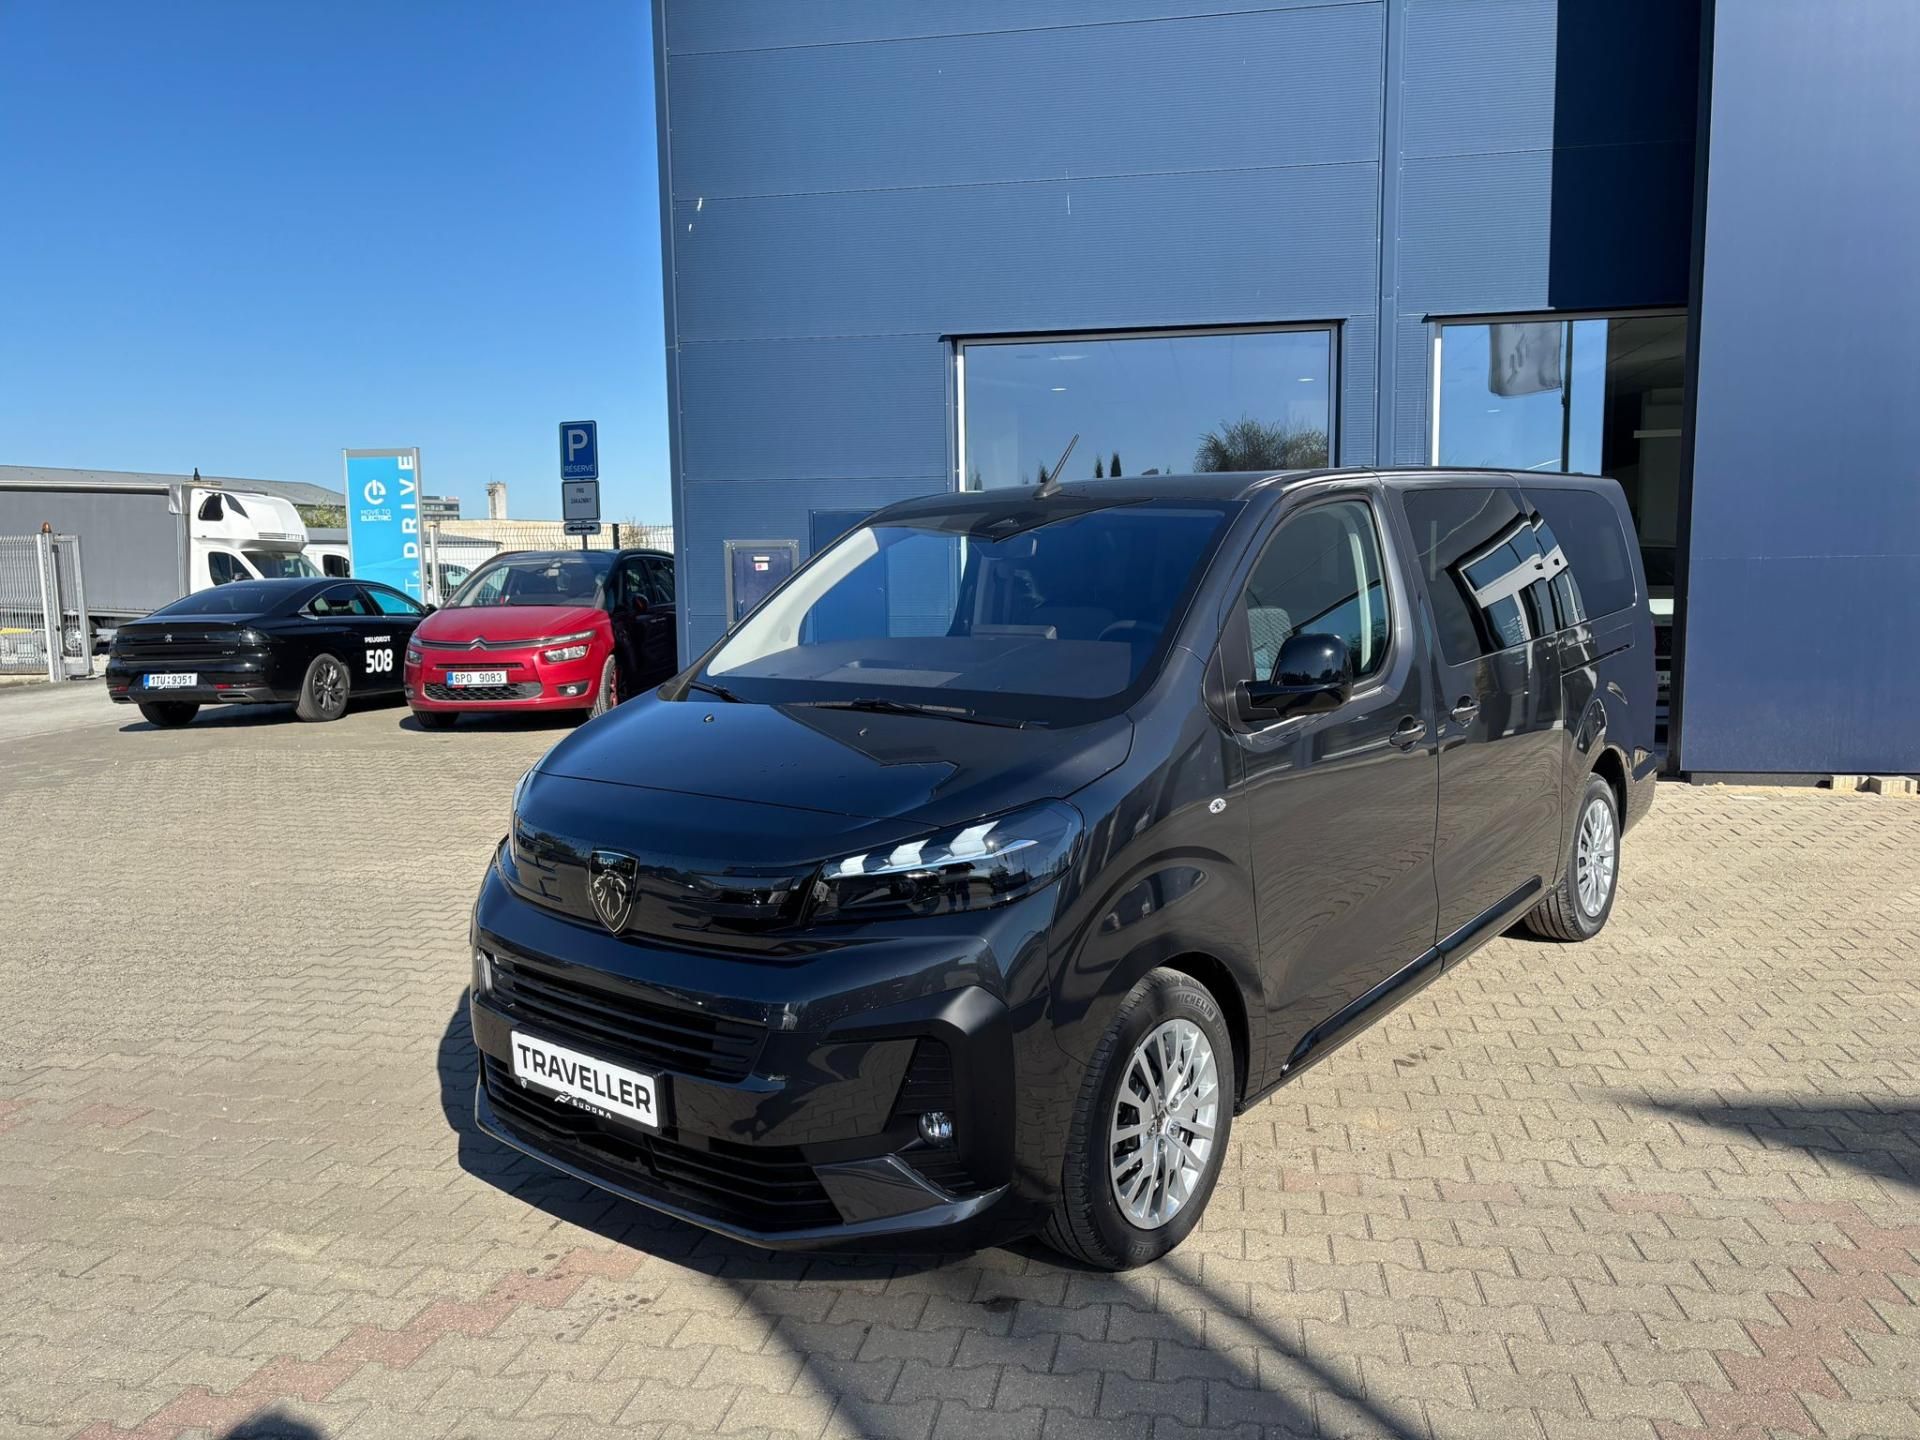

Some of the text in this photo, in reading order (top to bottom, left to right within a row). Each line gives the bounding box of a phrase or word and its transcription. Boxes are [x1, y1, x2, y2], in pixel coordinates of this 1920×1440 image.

[567, 429, 588, 462] P
[397, 455, 419, 559] DRIVE
[364, 635, 391, 643] PEUGEOT
[365, 648, 393, 673] 508
[172, 675, 193, 685] 9351
[479, 672, 503, 683] 9083
[517, 1043, 652, 1114] TRAVELLER
